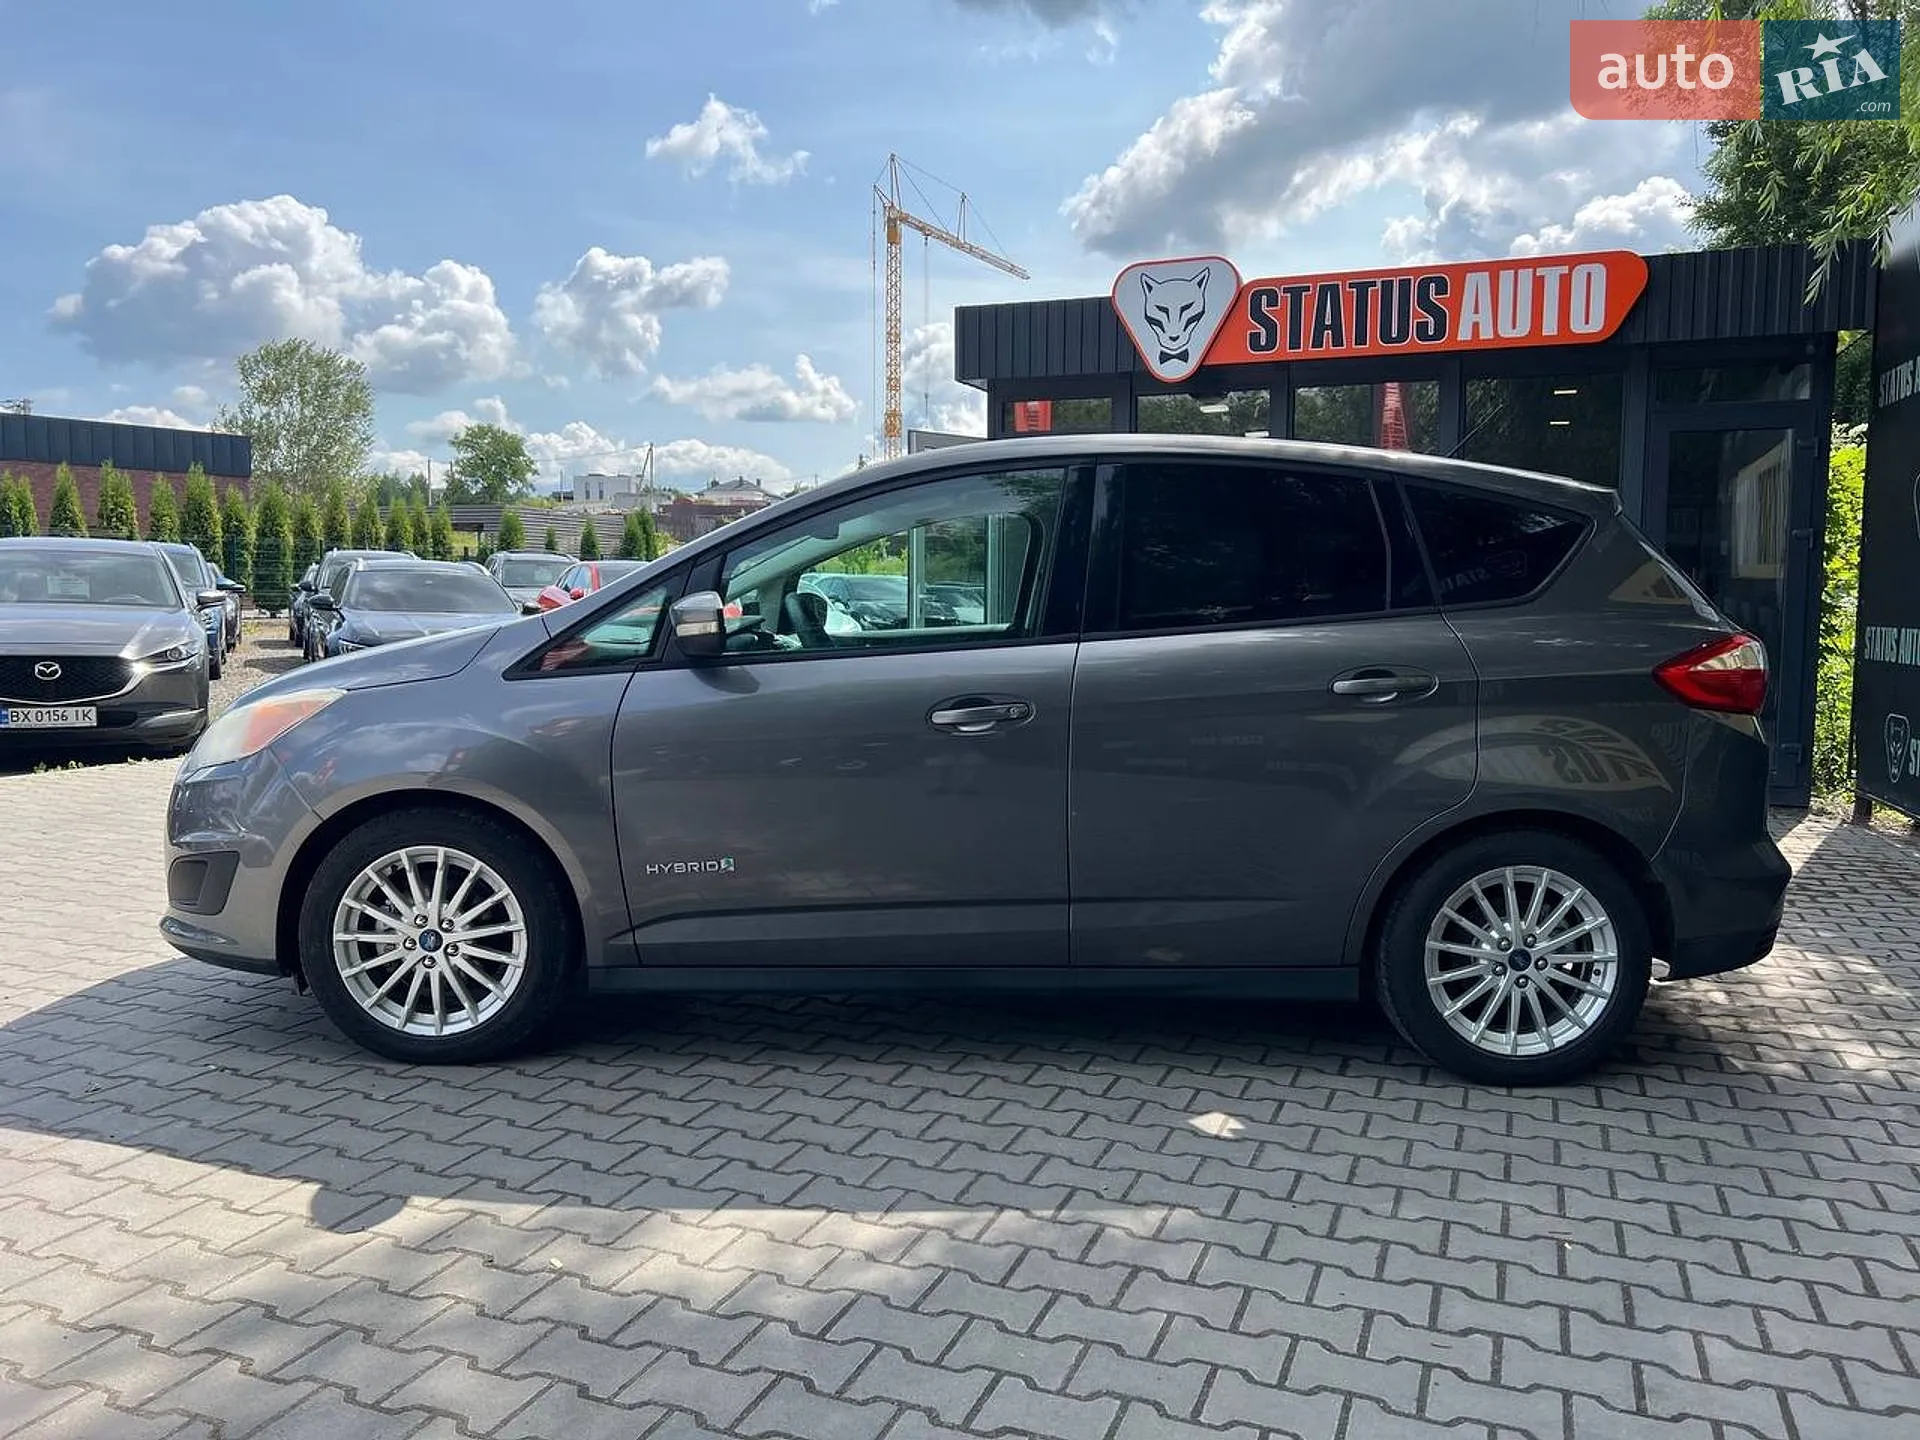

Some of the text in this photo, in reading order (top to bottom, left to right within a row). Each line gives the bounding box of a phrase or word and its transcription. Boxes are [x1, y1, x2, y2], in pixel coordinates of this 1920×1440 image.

[1246, 262, 1608, 354] STATUS AUTO
[1864, 626, 1898, 663] STATUS
[10, 709, 31, 723] BX
[35, 709, 68, 722] 0156
[75, 708, 92, 721] IK
[646, 861, 719, 874] HYBRID
